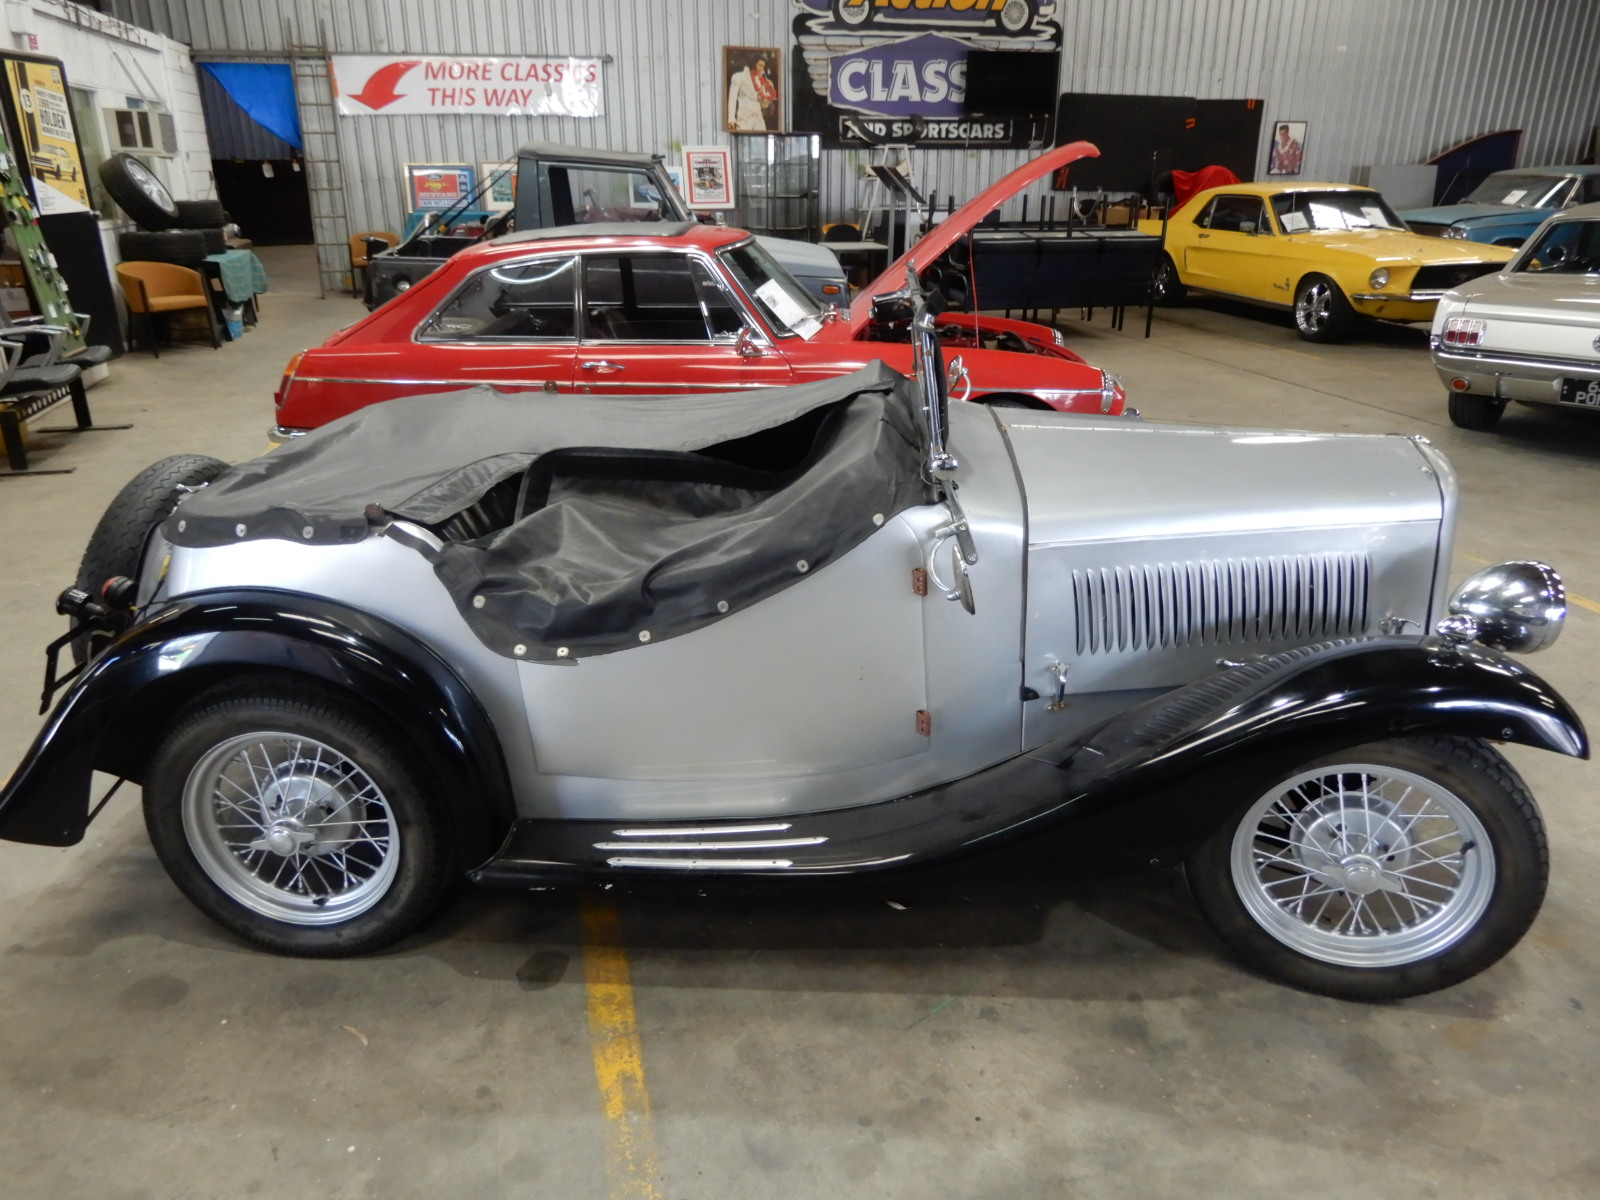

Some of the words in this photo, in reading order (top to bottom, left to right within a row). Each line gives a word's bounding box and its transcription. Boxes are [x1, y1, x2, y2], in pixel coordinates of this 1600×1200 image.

[425, 61, 493, 81] MORE
[501, 62, 597, 83] CLASSCS
[428, 88, 476, 106] THIS
[484, 88, 533, 107] WAY
[40, 109, 67, 130] HOLDEN
[1588, 381, 1600, 393] 6
